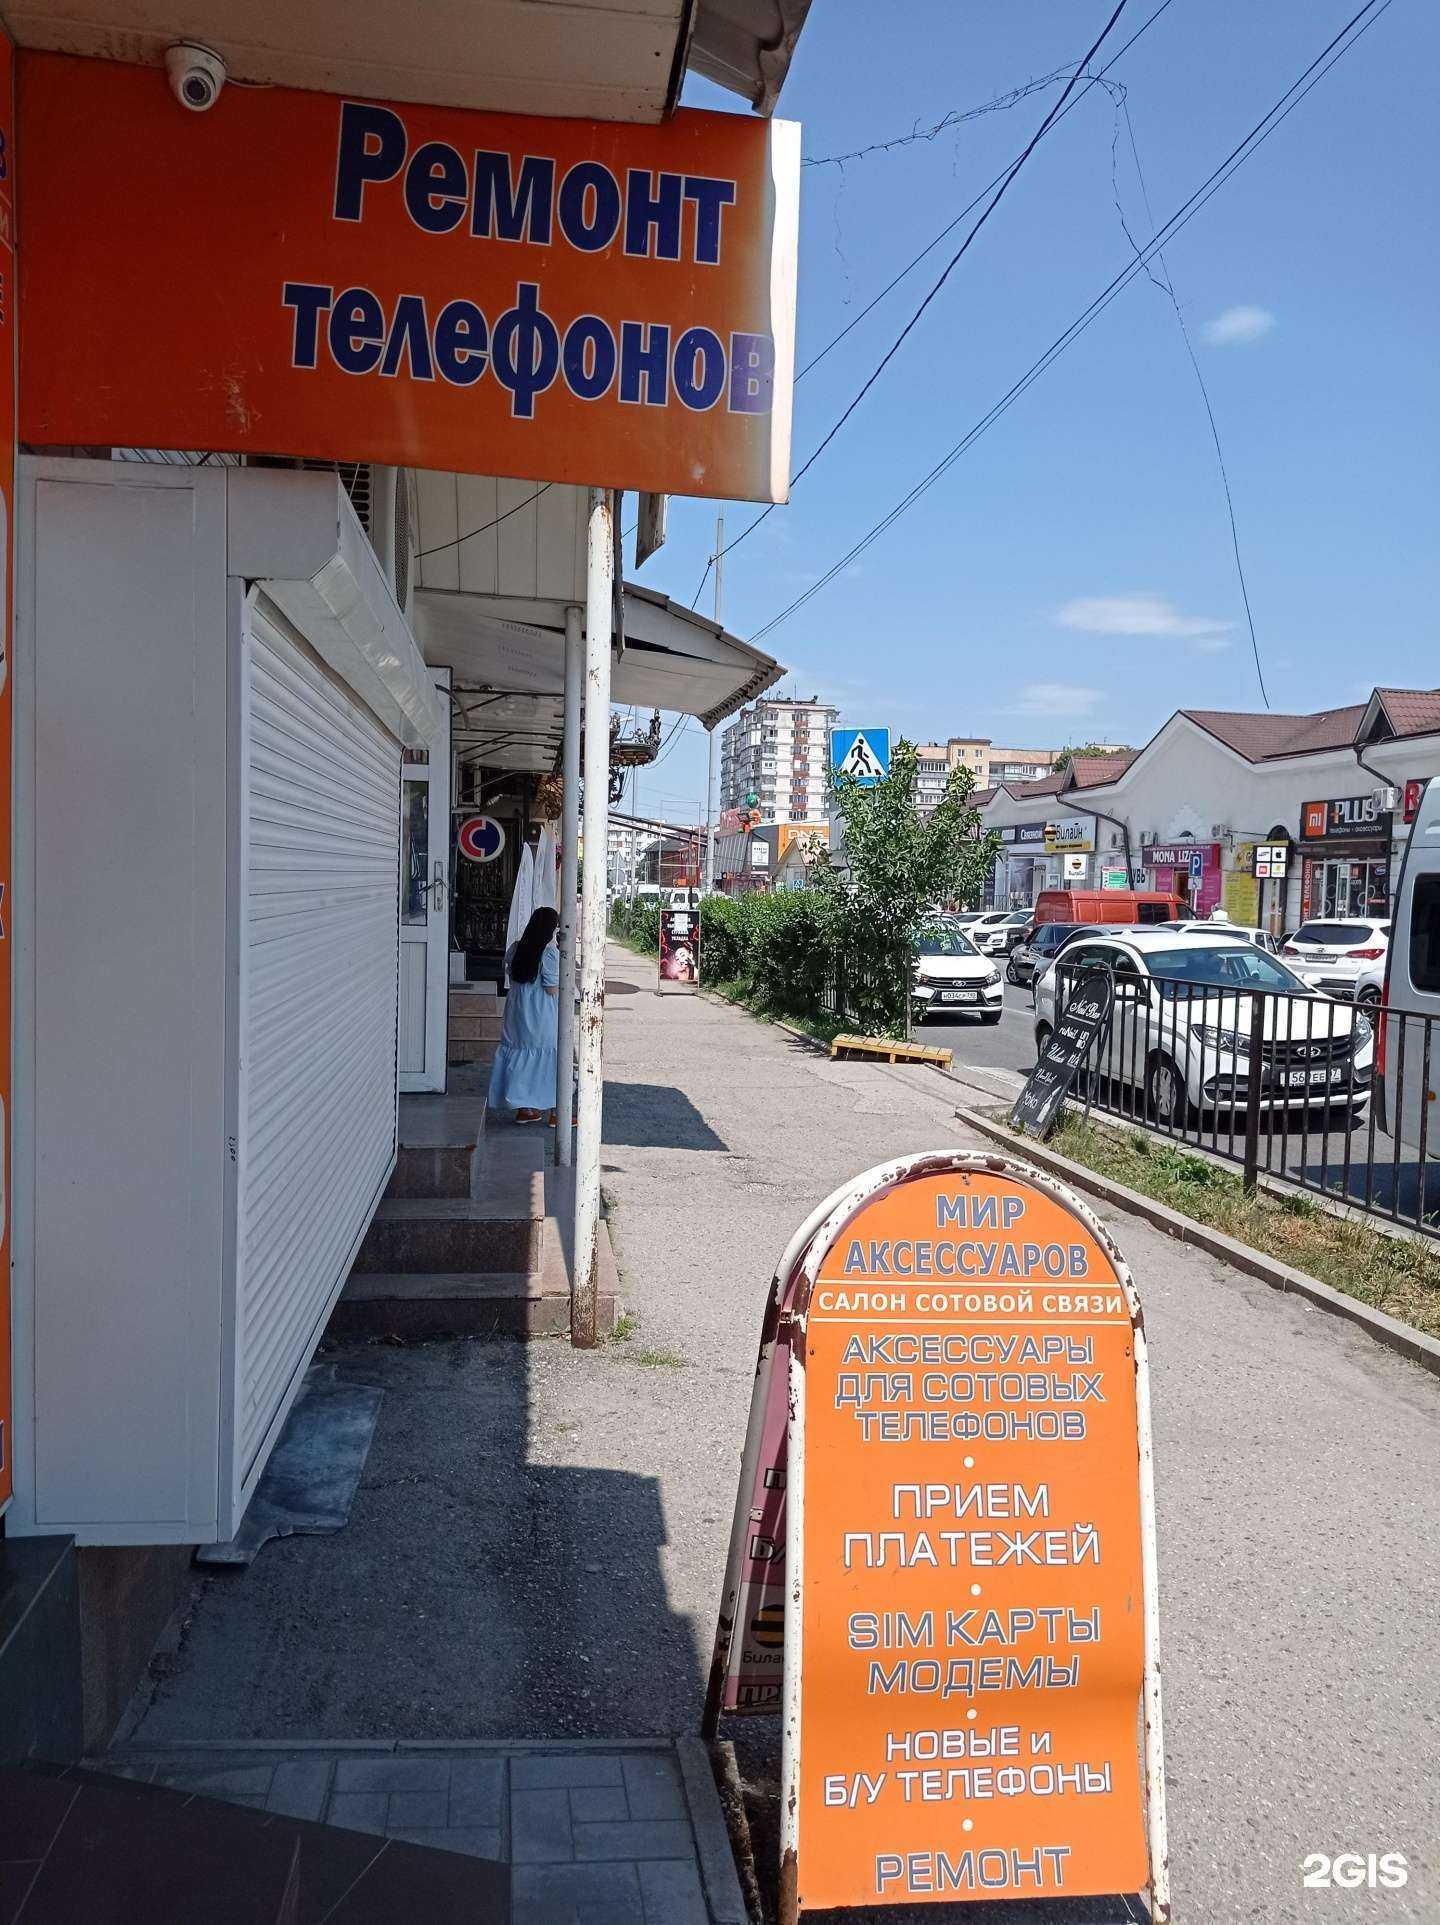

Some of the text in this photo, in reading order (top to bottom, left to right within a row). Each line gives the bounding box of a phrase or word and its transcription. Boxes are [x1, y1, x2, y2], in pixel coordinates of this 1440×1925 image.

[332, 99, 738, 266] Ремонт
[282, 280, 776, 421] телефонов
[1152, 851, 1175, 863] MONA
[936, 1194, 1026, 1229] МИР
[844, 1241, 1089, 1278] АКСЕССУАРОВ
[818, 1289, 1123, 1314] САЛОН СОТОВОЙ СВЯЗИ
[842, 1335, 1094, 1366] АКСЕССУАРЫ
[834, 1372, 1108, 1409] ДЛЯ СОТОВЫХ
[854, 1411, 1088, 1442] ТЕЛЕФОНОВ
[891, 1483, 1050, 1519] ПРИЕМ
[842, 1523, 1101, 1569] ПЛАТЕЖЕЙ
[848, 1607, 1101, 1650] SIM КАРТЫ
[743, 1650, 785, 1665] Била
[866, 1655, 1080, 1700] МОДЕМЫ
[885, 1725, 1021, 1762] НОВЫЕ
[823, 1762, 1113, 1807] Б/У ТЕЛЕФОНЫ
[874, 1845, 1071, 1894] РЕМОНТ
